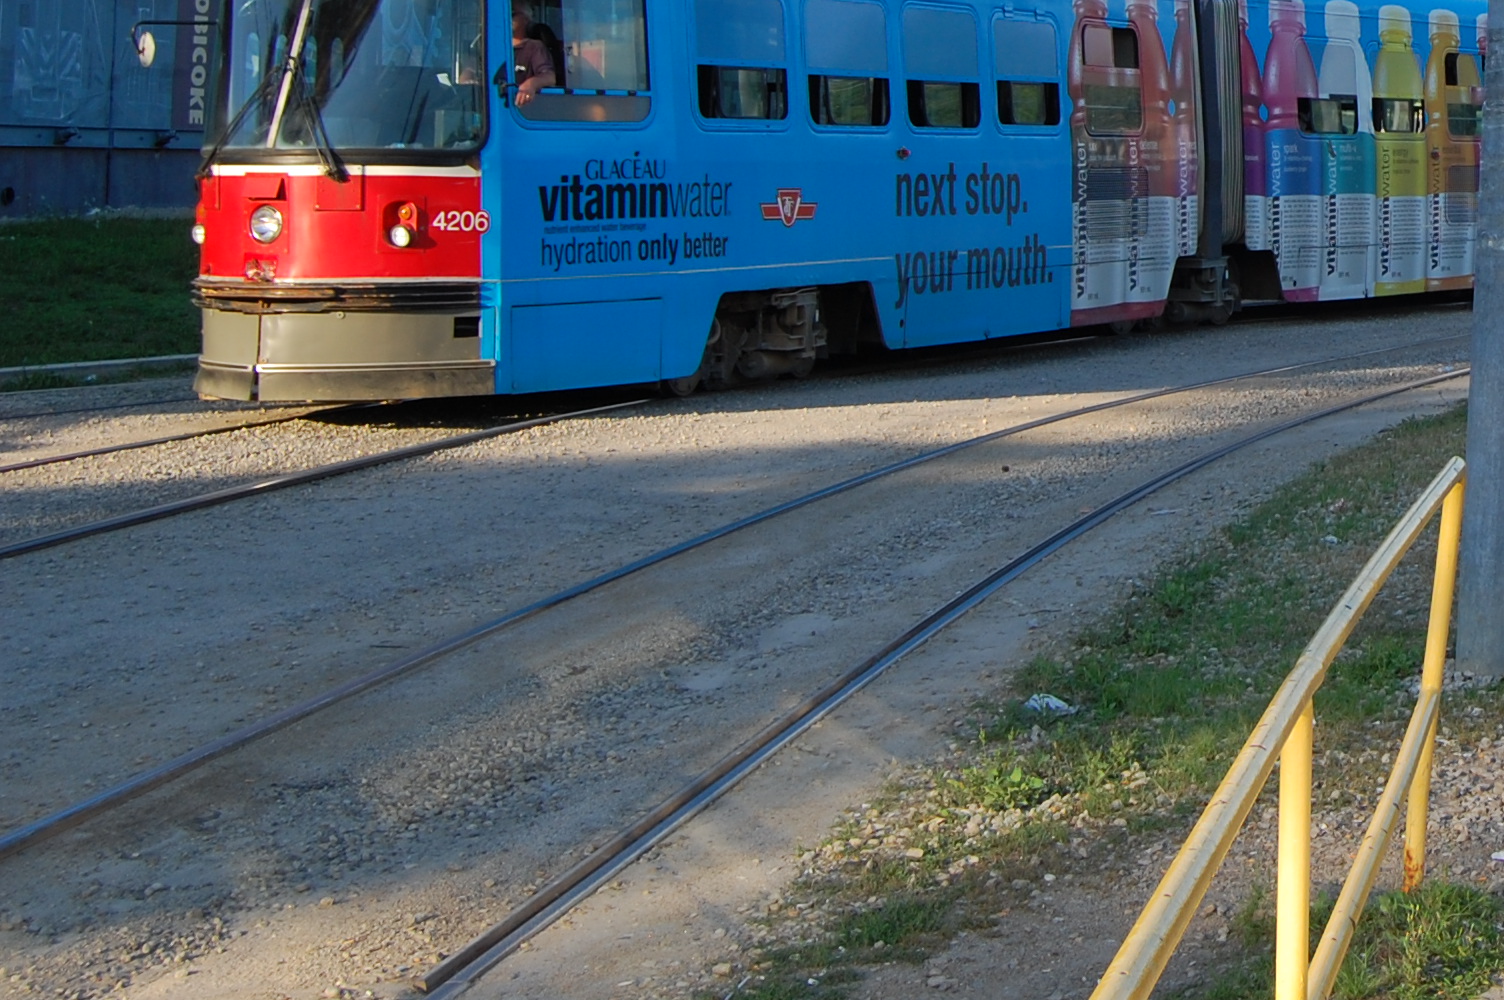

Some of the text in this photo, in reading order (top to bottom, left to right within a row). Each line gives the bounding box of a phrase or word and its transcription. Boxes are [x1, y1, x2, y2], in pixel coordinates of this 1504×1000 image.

[584, 150, 667, 181] GLACÉAU
[895, 161, 1029, 227] next stop.
[432, 210, 490, 232] 4206
[538, 173, 733, 222] vitaminwater
[1380, 145, 1391, 277] vitaminwater
[1430, 144, 1440, 270] vitaminwatr
[541, 231, 729, 272] hydration only better
[894, 232, 1053, 310] your mouth.
